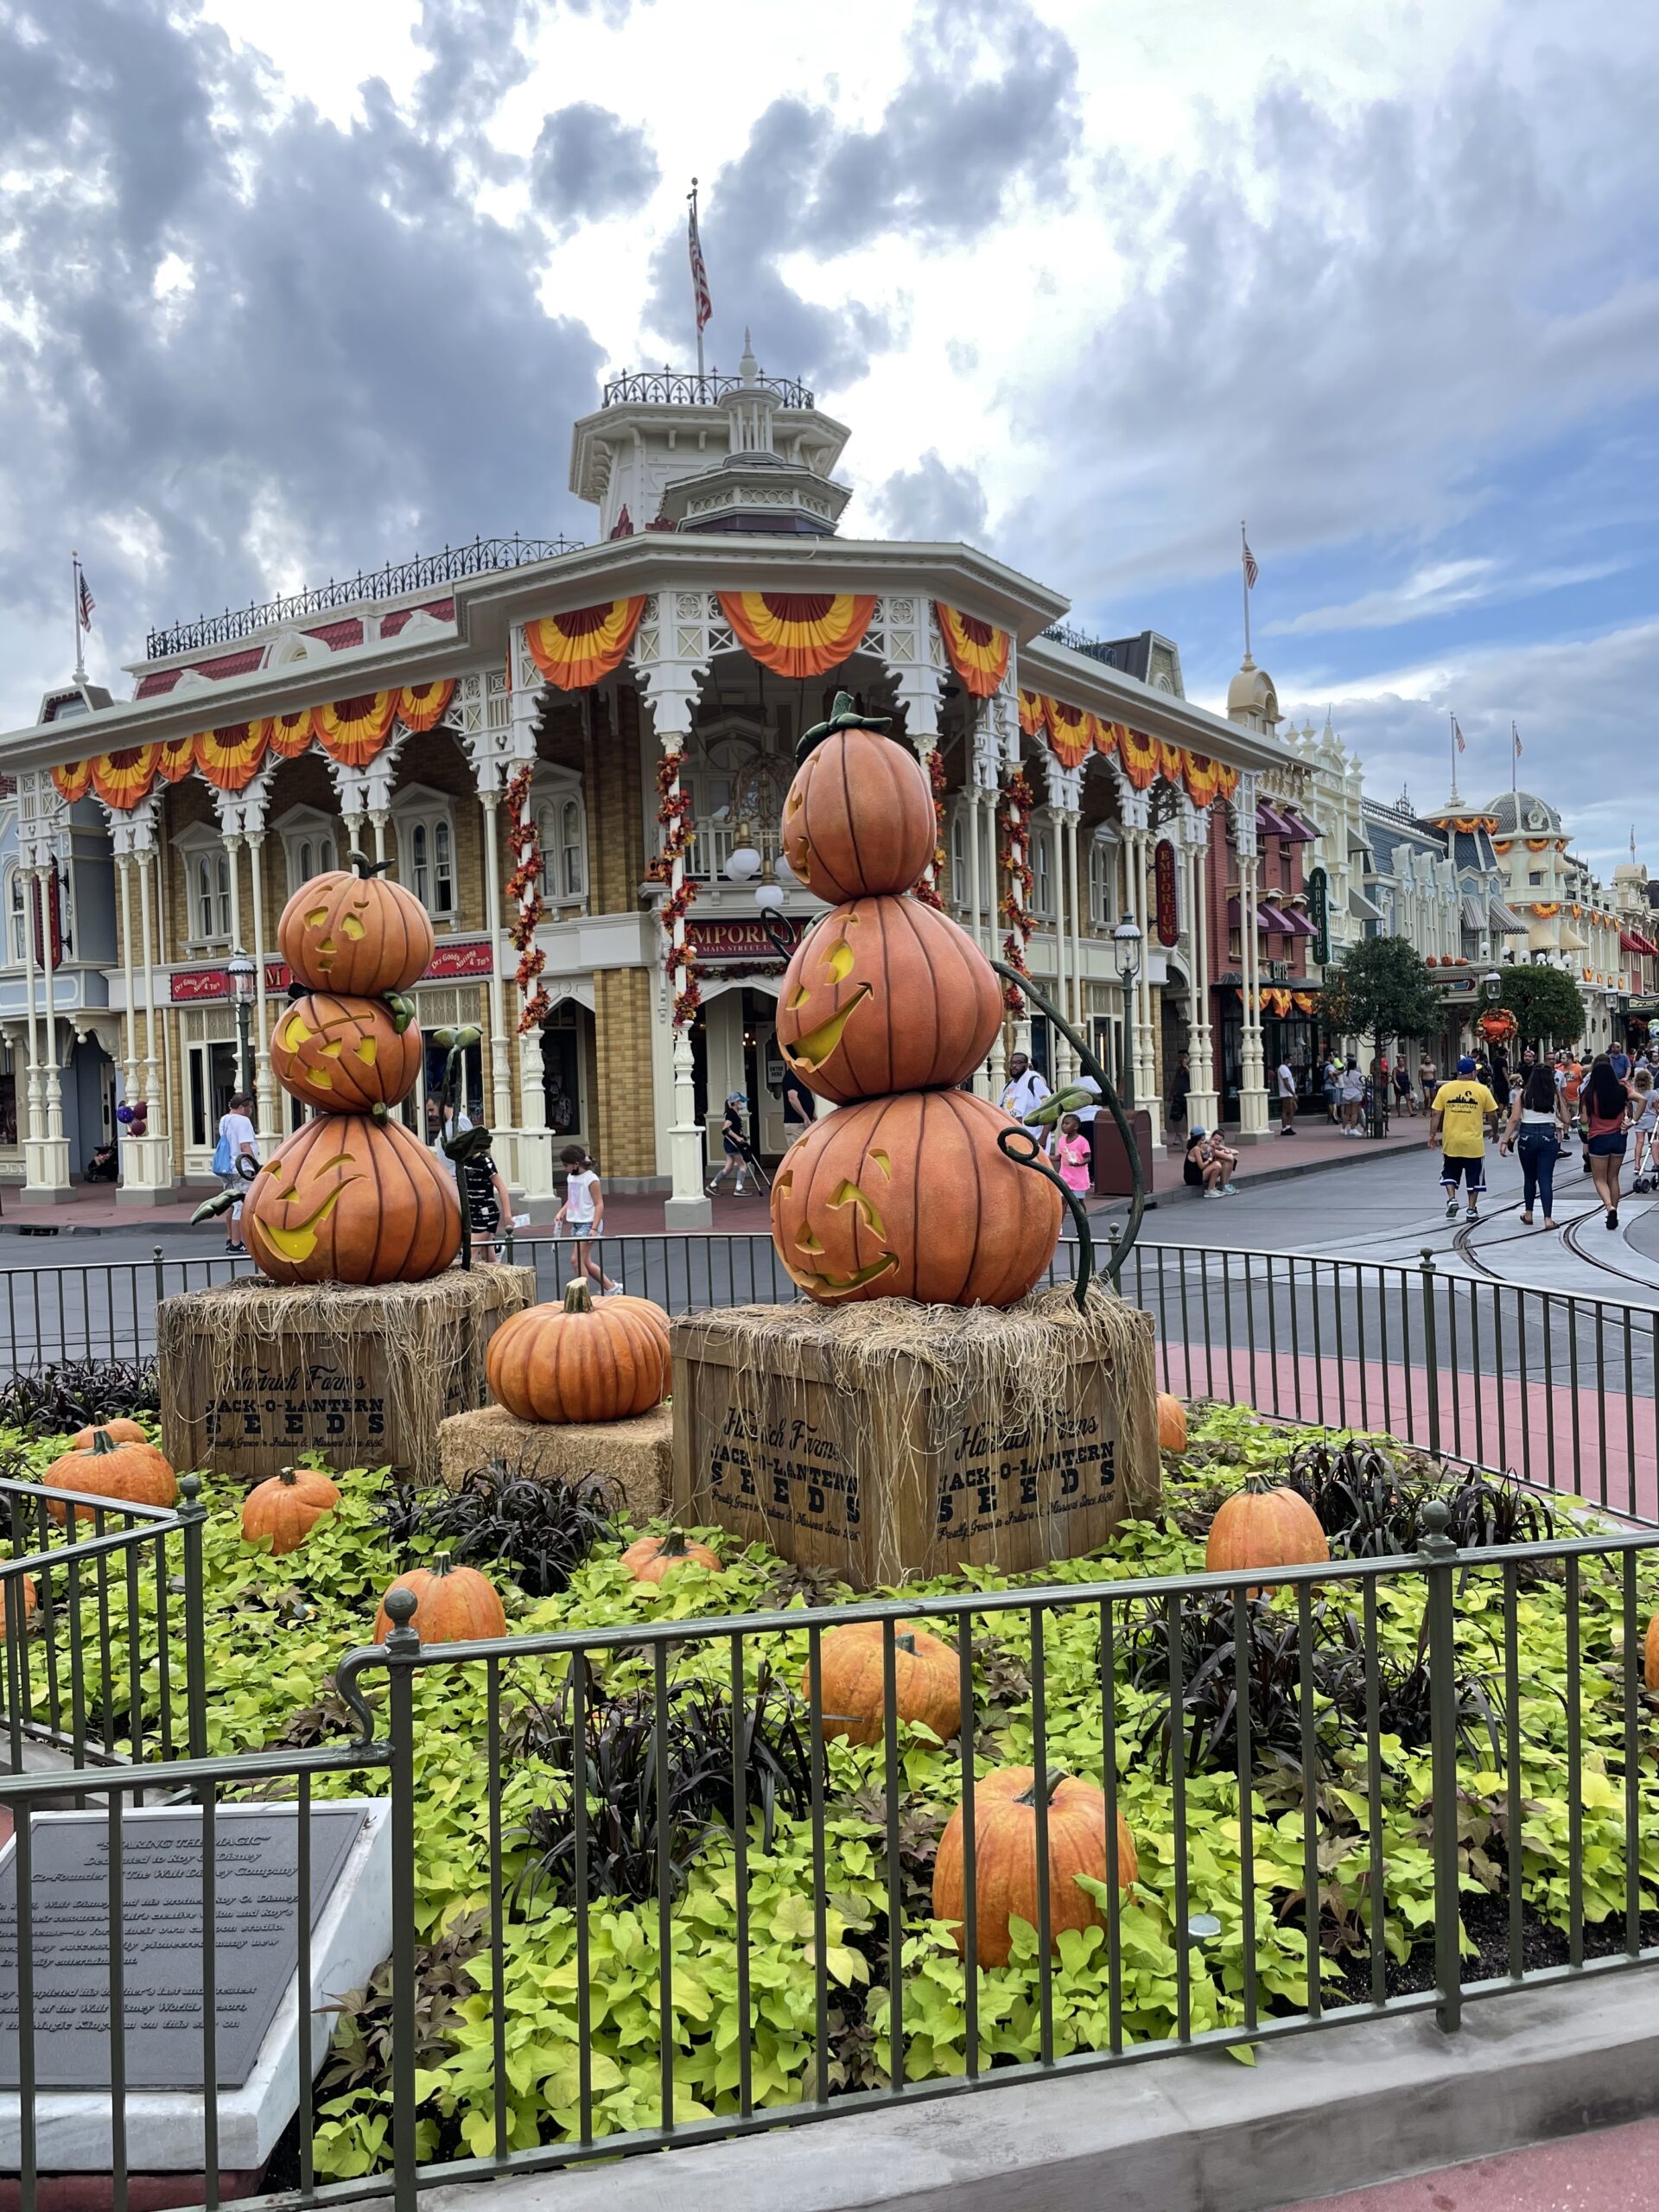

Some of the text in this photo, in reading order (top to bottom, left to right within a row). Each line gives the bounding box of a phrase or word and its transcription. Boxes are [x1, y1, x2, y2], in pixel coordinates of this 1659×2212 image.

[1160, 850, 1174, 935] EMPORIUM
[1315, 875, 1324, 957] ARCADE
[432, 953, 461, 969] Dry Goods
[455, 950, 476, 969] Notions
[469, 957, 490, 967] & Toys
[175, 983, 183, 993] Dry
[194, 976, 210, 993] Notions
[205, 1398, 384, 1414] JACK-O-LANTERN
[207, 1414, 384, 1434] SEEDS
[300, 1437, 308, 1447] &
[710, 1443, 858, 1496] JACK-O-LANTERN
[938, 1440, 1115, 1494] JACK-O-LANTERN
[710, 1460, 860, 1524] SEEDS
[938, 1459, 1115, 1524] SEEDS
[168, 1854, 195, 1865] Roy
[215, 1853, 262, 1863] Disney
[31, 1872, 107, 1883] Co-Founder
[126, 1871, 150, 1879] The
[154, 1870, 184, 1879] Walt
[234, 1866, 298, 1878] Company
[73, 1901, 109, 1910] Disney
[260, 1909, 293, 1918] Roy's
[124, 1927, 155, 1936] their
[241, 1923, 285, 1933] studio.
[251, 1939, 279, 1948] new
[79, 1988, 99, 1997] his
[156, 1986, 181, 1996] last
[39, 2005, 55, 2014] of
[56, 2005, 77, 2013] the
[79, 2004, 109, 2013] Walt
[162, 2019, 188, 2030] this
